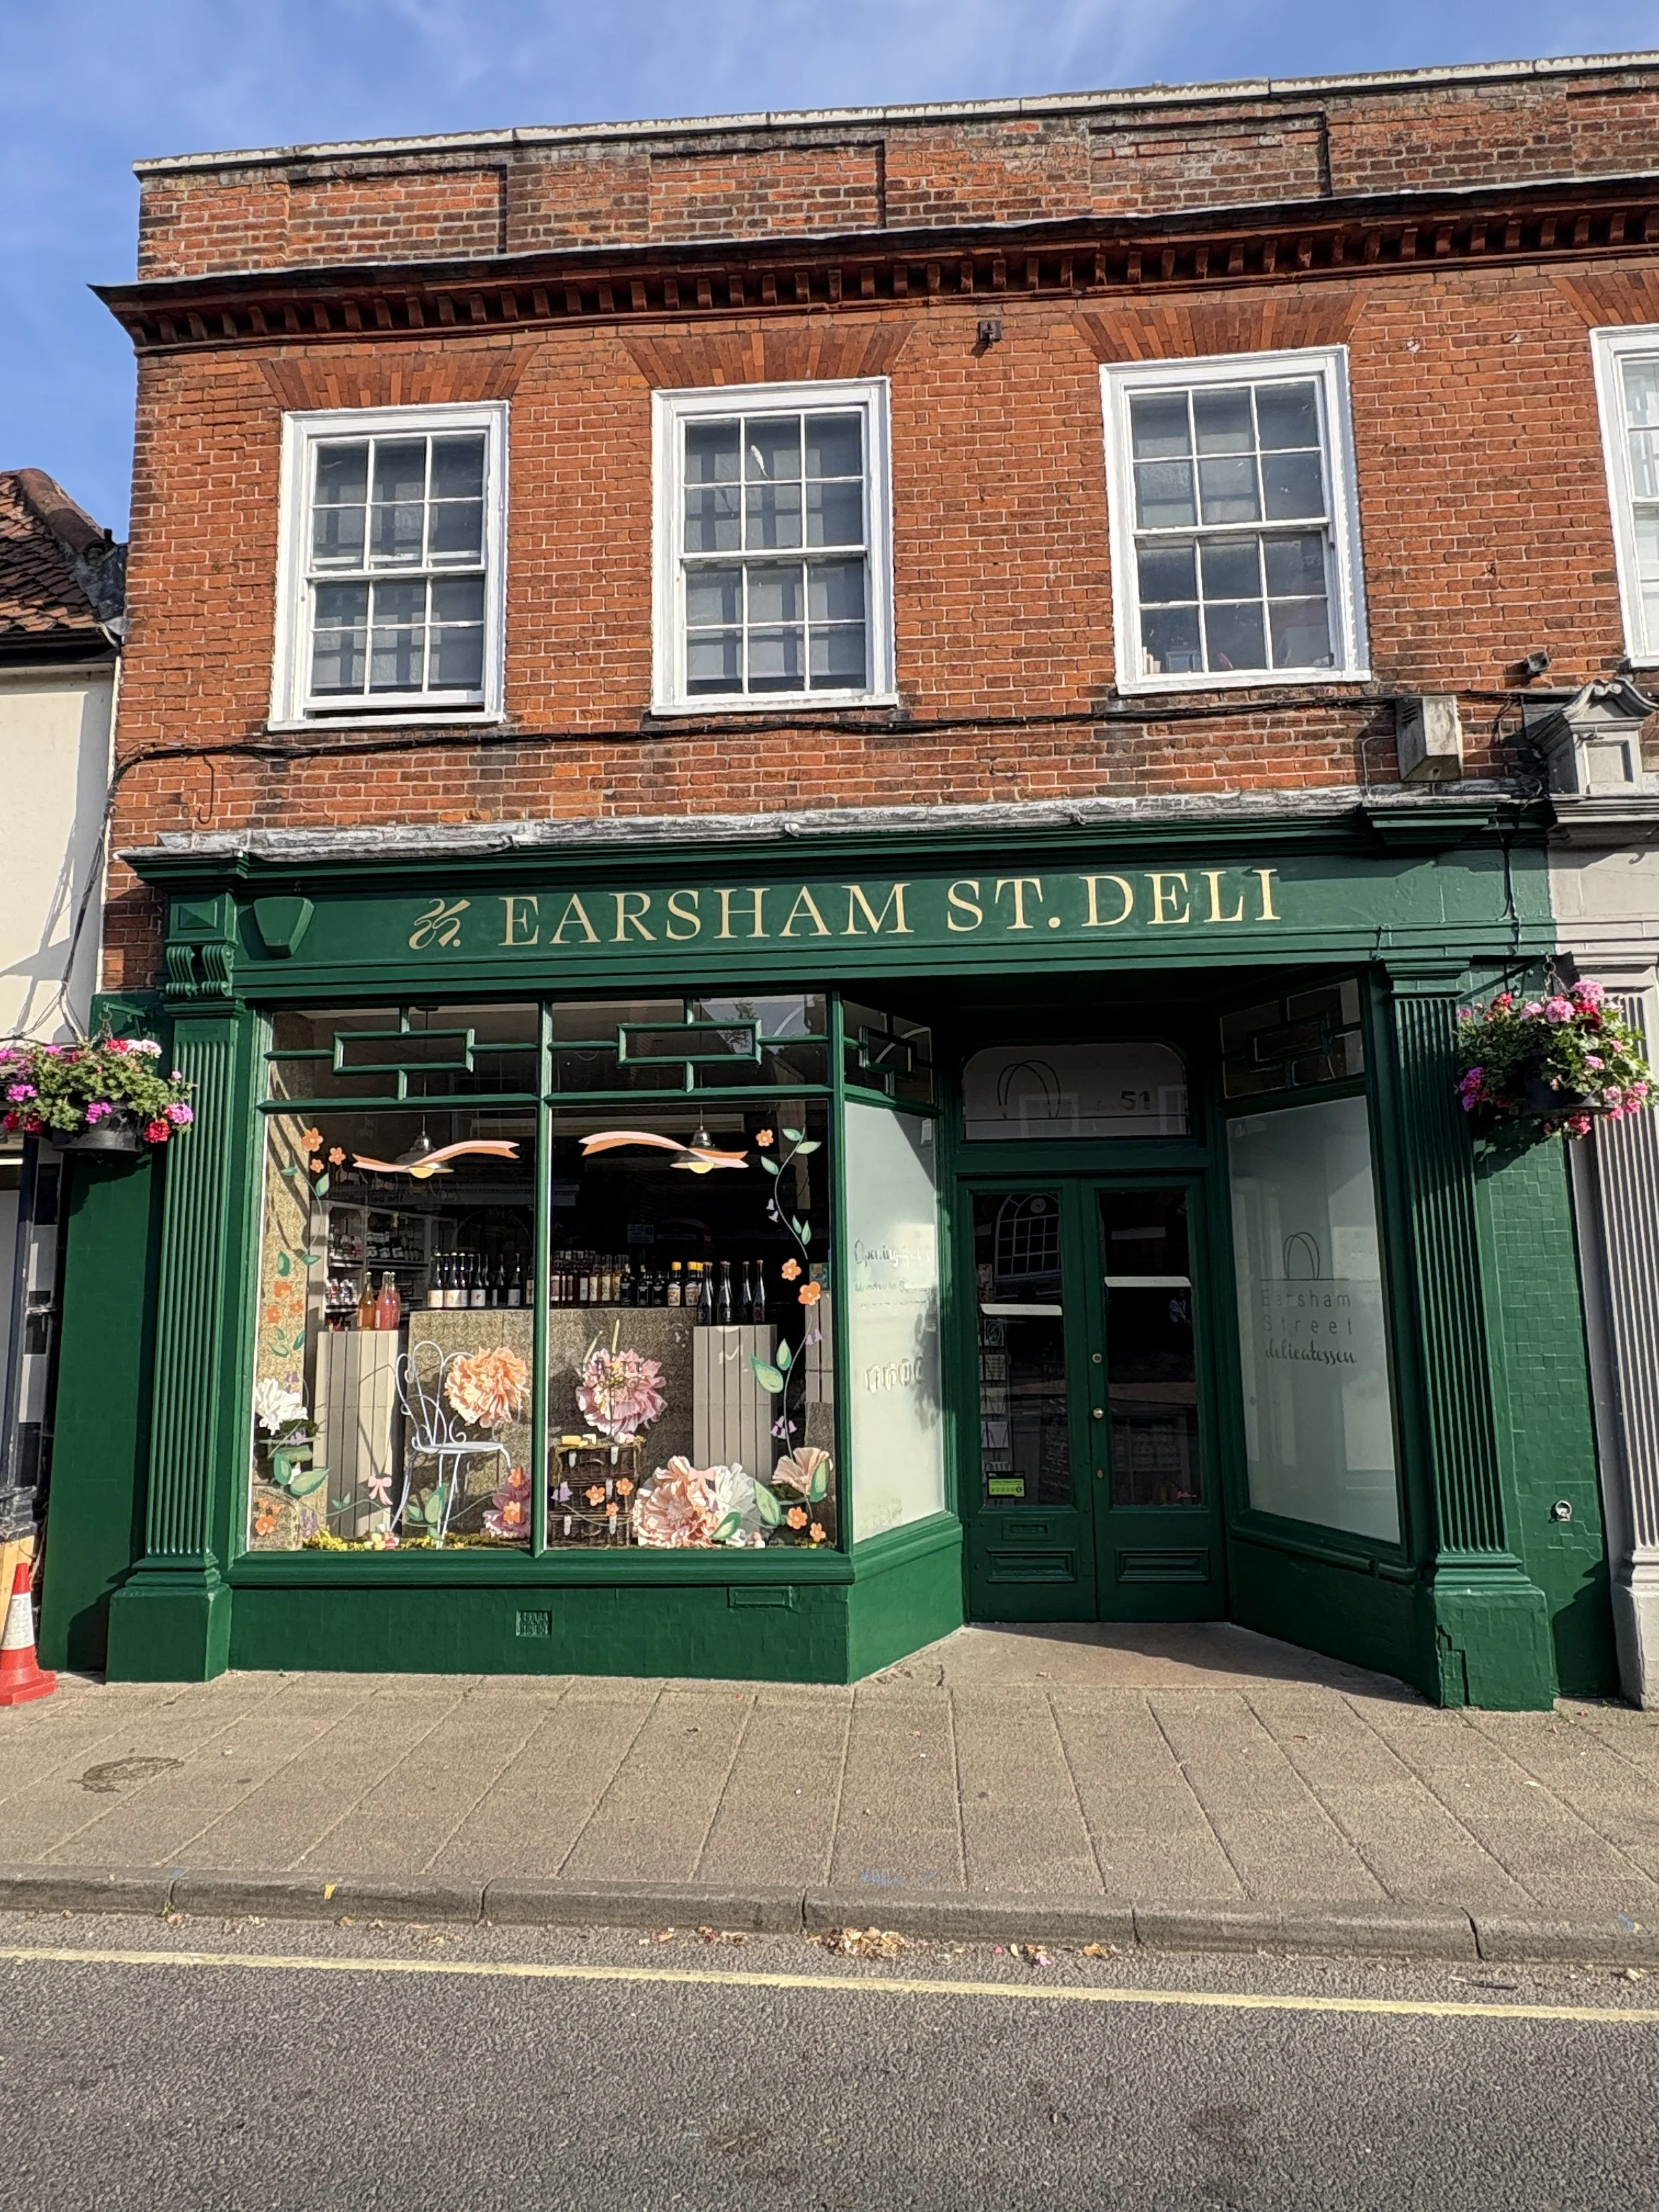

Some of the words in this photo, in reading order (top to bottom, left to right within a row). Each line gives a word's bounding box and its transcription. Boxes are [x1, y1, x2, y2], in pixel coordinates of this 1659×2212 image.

[500, 882, 914, 946] EARSHAM
[946, 877, 1062, 932] ST.
[1080, 868, 1282, 928] DELI
[1120, 1090, 1151, 1111] 51
[1261, 1288, 1351, 1308] Earsham
[1263, 1313, 1353, 1335] Street
[1264, 1337, 1358, 1366] delicatessen
